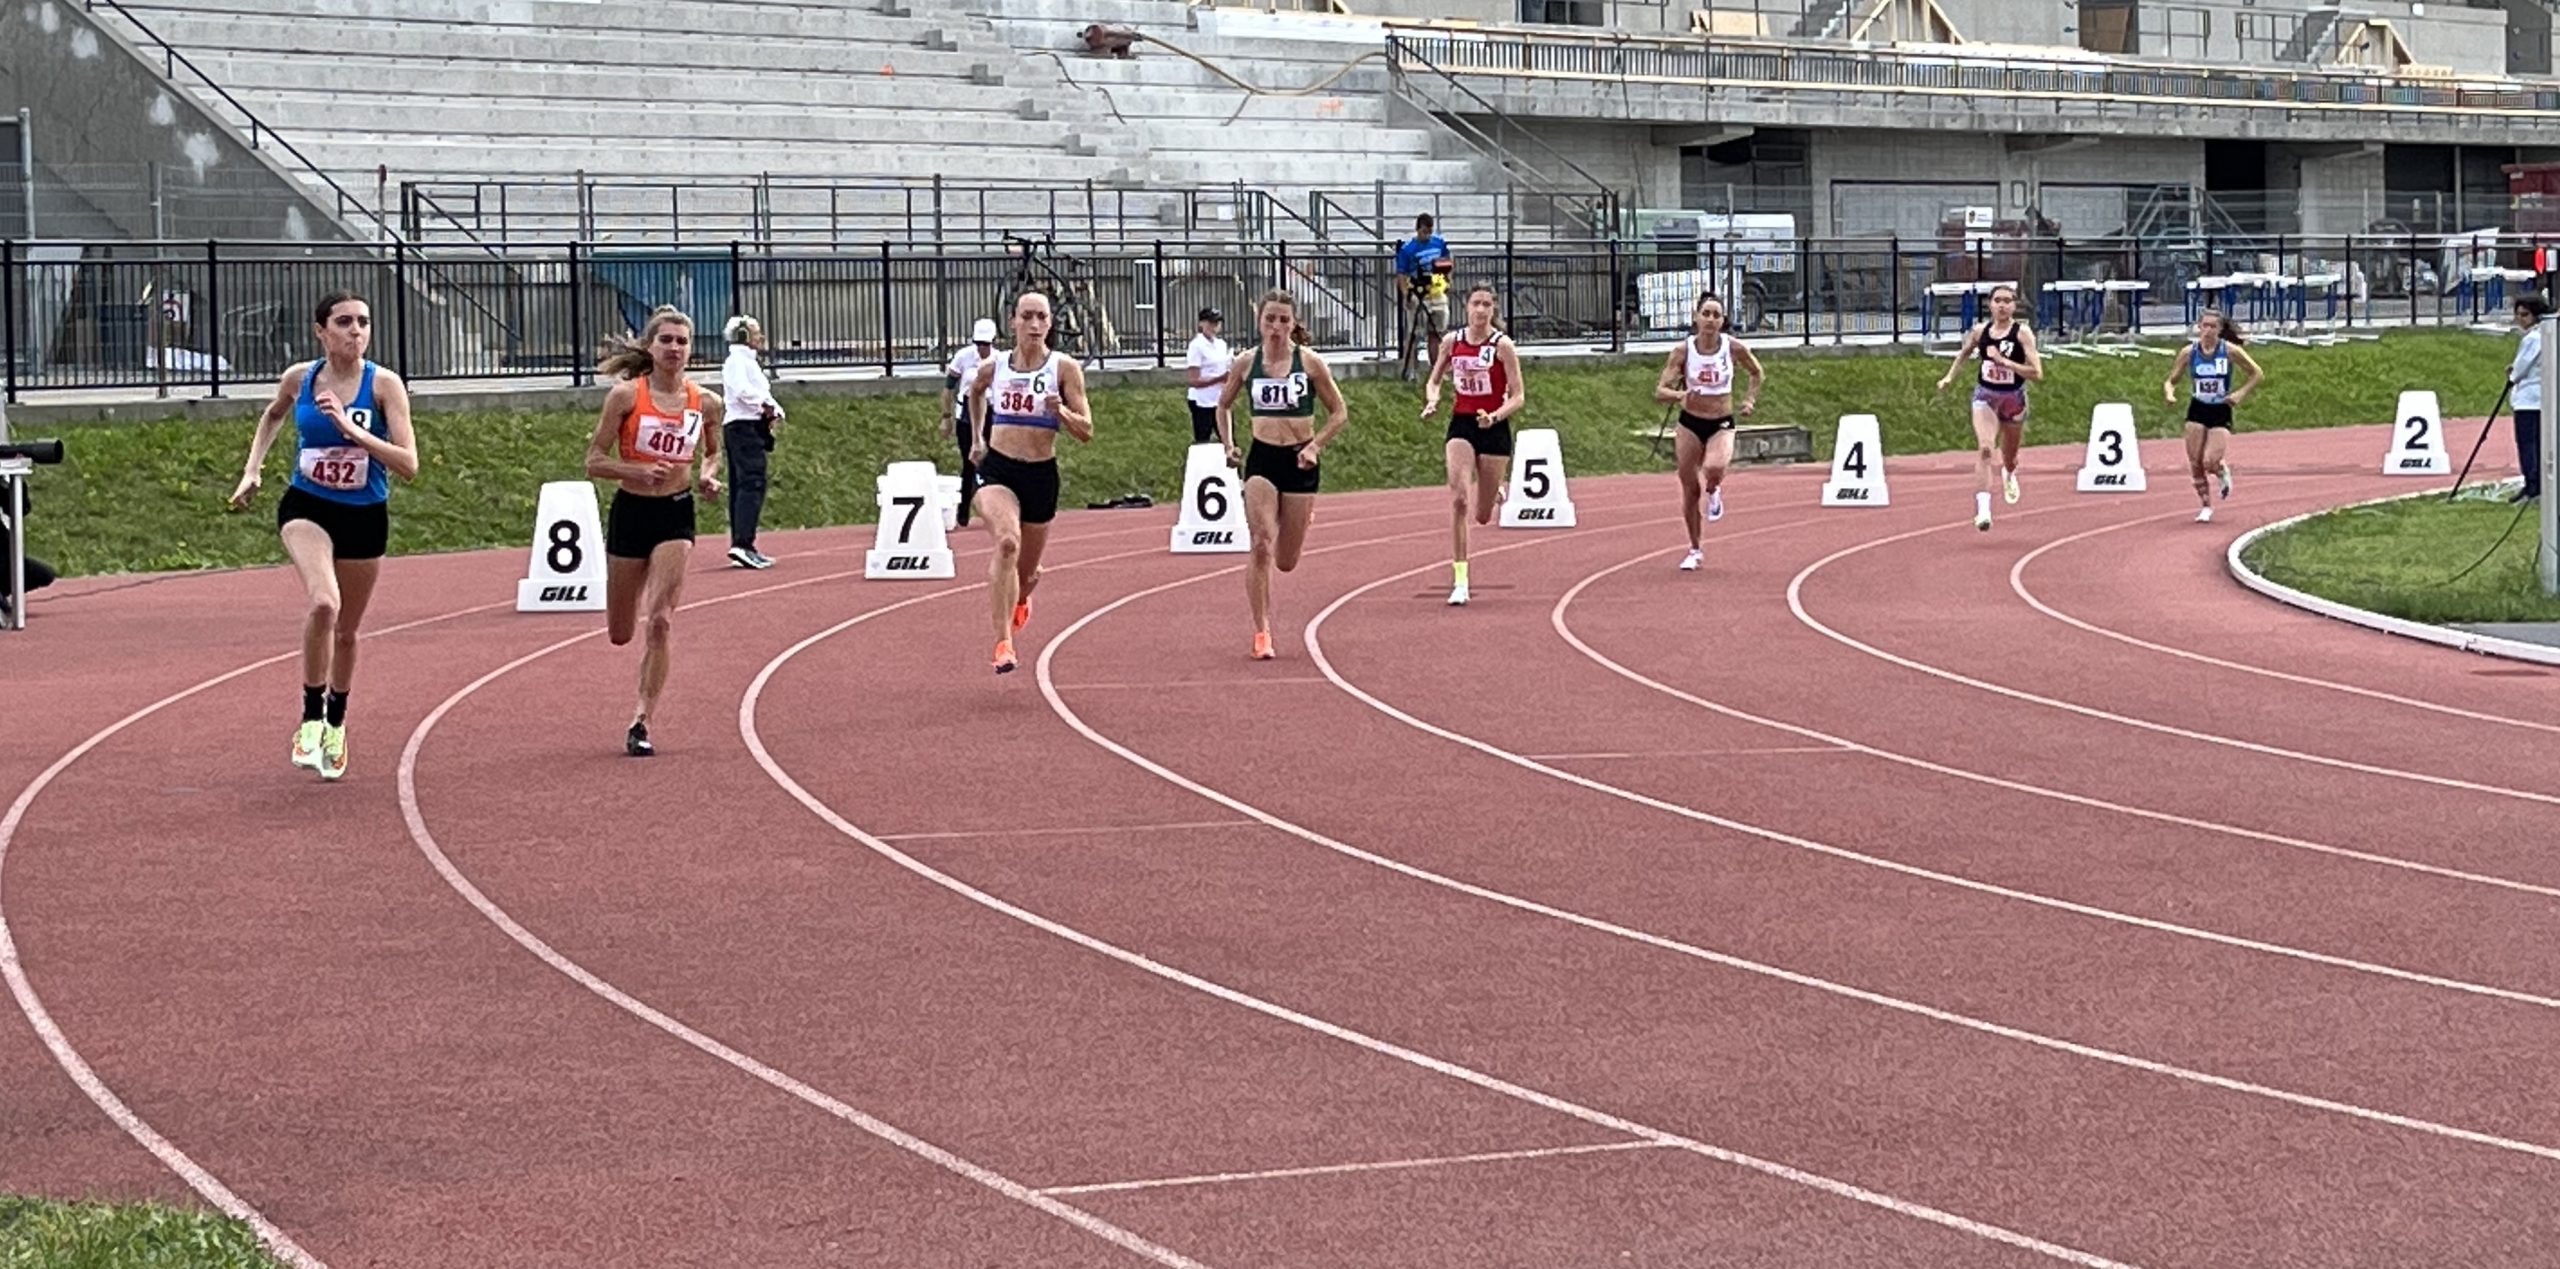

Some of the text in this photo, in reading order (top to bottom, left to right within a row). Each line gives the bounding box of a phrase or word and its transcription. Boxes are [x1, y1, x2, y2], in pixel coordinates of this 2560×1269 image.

[1482, 348, 1491, 362] 4
[1033, 373, 1045, 394] 6
[1261, 385, 1289, 404] 871
[1294, 374, 1304, 395] 5
[1000, 392, 1034, 413] 384
[687, 412, 700, 436] 7
[2405, 416, 2429, 450] 2
[648, 431, 686, 455] 401
[2099, 430, 2123, 466] 3
[1842, 441, 1867, 479] 4
[312, 461, 356, 484] 432
[1522, 458, 1550, 499] 5
[1197, 476, 1227, 521] 6
[892, 496, 925, 544] 7
[1517, 508, 1555, 520] GILL
[547, 519, 582, 573] 8
[1192, 531, 1233, 545] GILL
[886, 556, 930, 570] GILL
[539, 586, 588, 601] GILL
